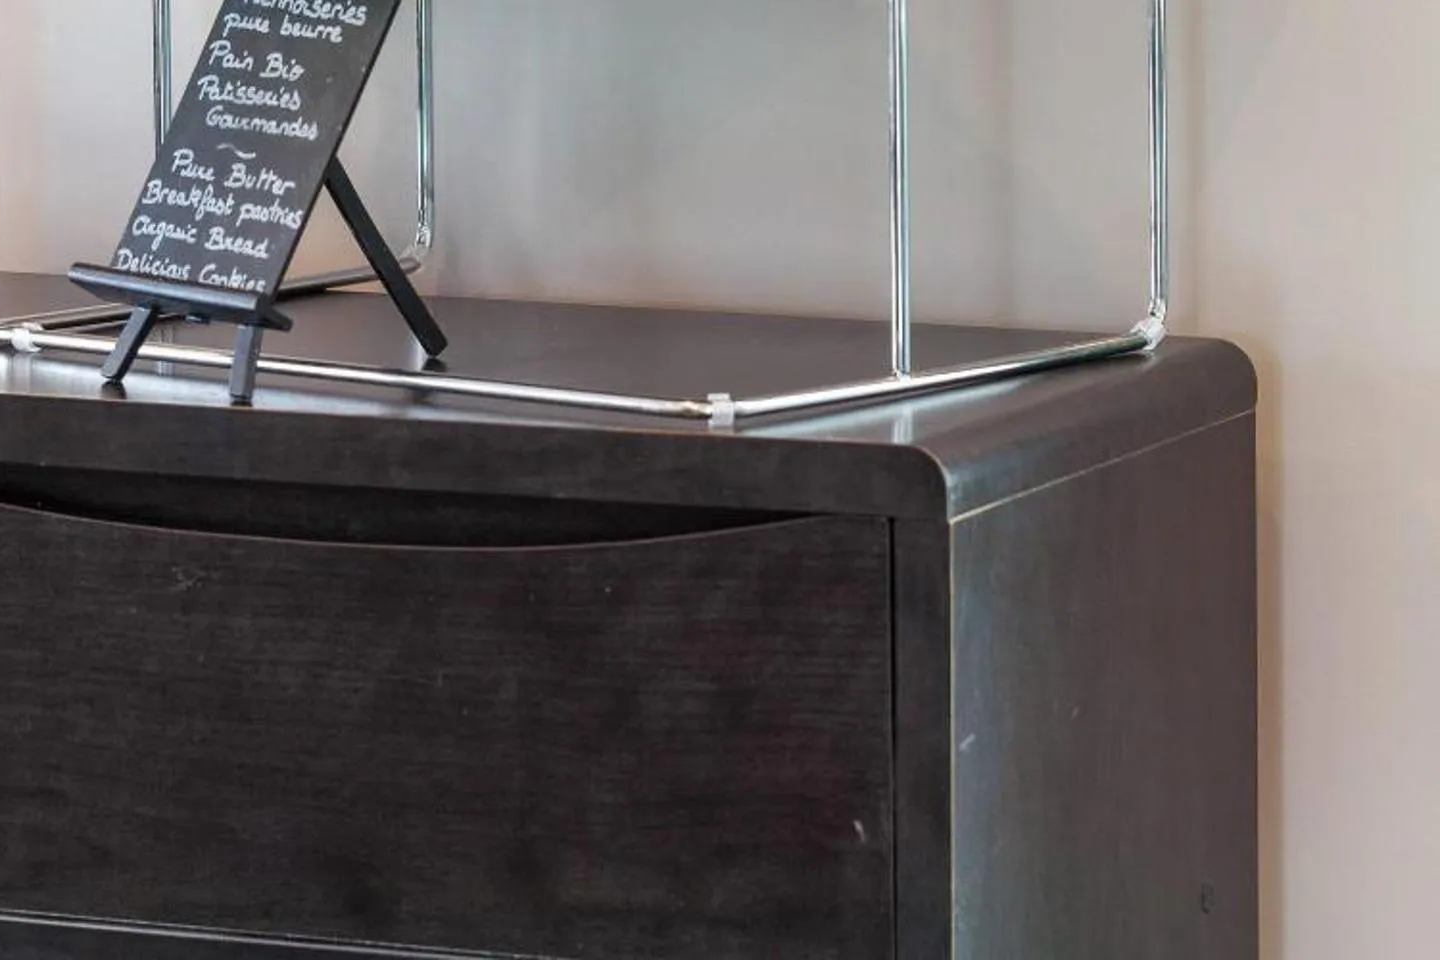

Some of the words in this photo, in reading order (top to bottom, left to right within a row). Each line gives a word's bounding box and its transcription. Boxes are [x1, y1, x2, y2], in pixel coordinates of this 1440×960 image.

[223, 12, 271, 38] pure
[279, 14, 343, 43] beurre
[209, 40, 255, 72] Pain
[259, 52, 306, 82] Bio
[205, 104, 319, 141] Gourmandes
[171, 148, 216, 181] Pure
[223, 162, 296, 197] Butter
[141, 178, 235, 221] Breakfast
[235, 197, 305, 230] pastries
[132, 214, 198, 252] Organic
[204, 226, 269, 259] Bread
